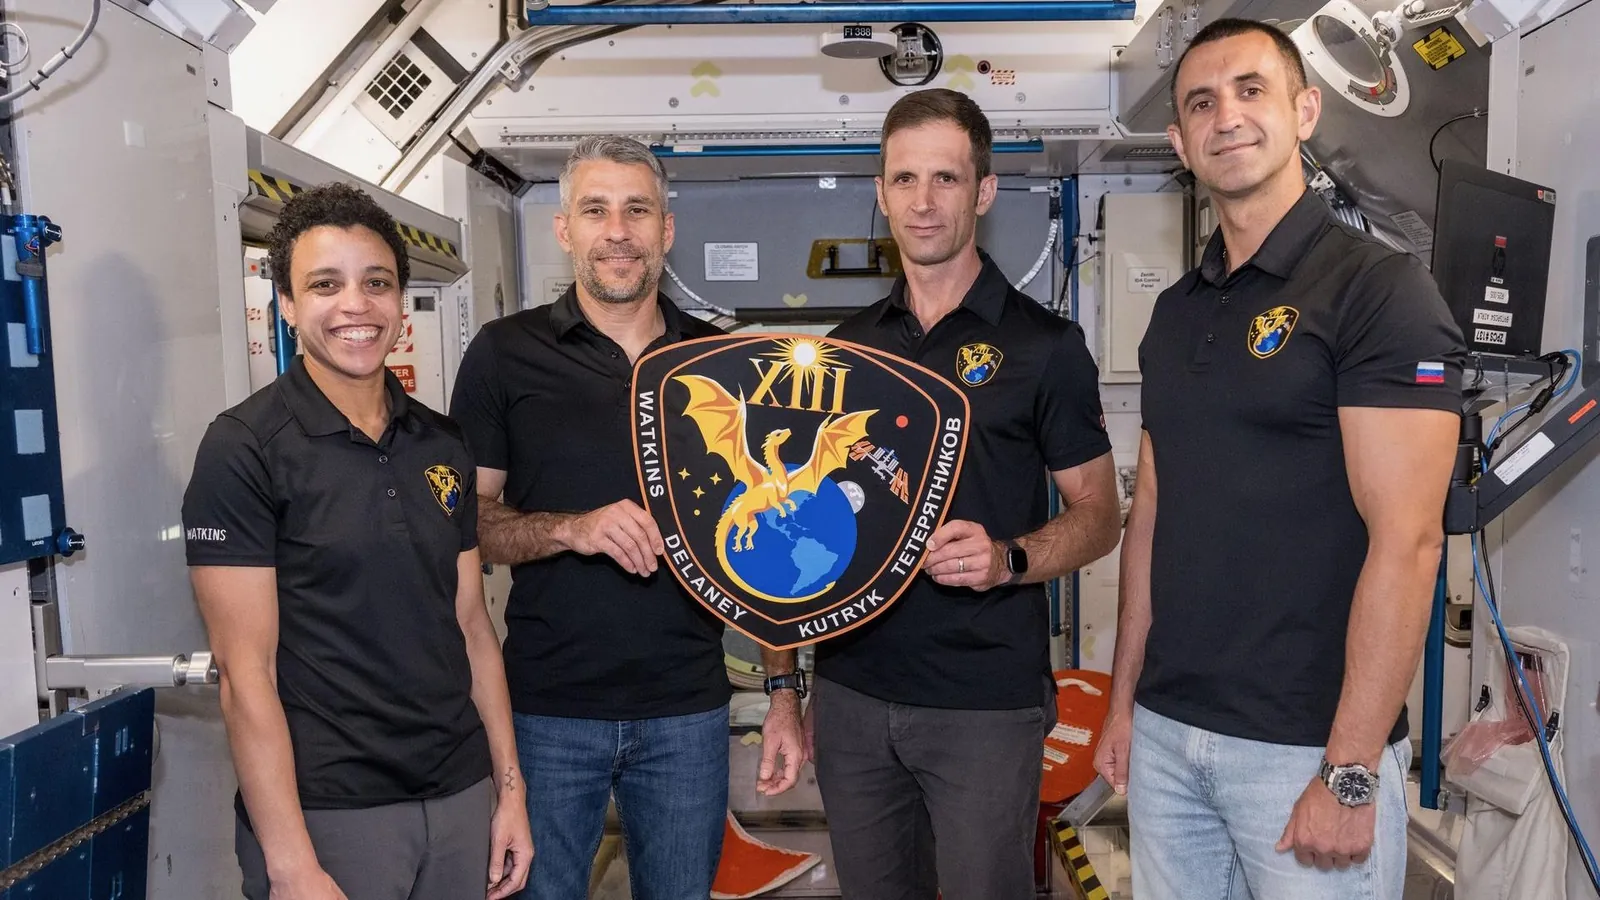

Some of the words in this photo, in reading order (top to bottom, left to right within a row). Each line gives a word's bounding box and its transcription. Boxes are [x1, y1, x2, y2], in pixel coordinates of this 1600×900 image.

[844, 27, 853, 36] FI
[855, 27, 871, 37] 388
[746, 357, 852, 415] XIII
[639, 390, 665, 498] WATKINS
[890, 417, 962, 576] ТЕТЕРЯТНИКОВ
[186, 527, 227, 541] WATKINS
[664, 533, 748, 621] DELANEY
[798, 588, 885, 638] KUTRYK
